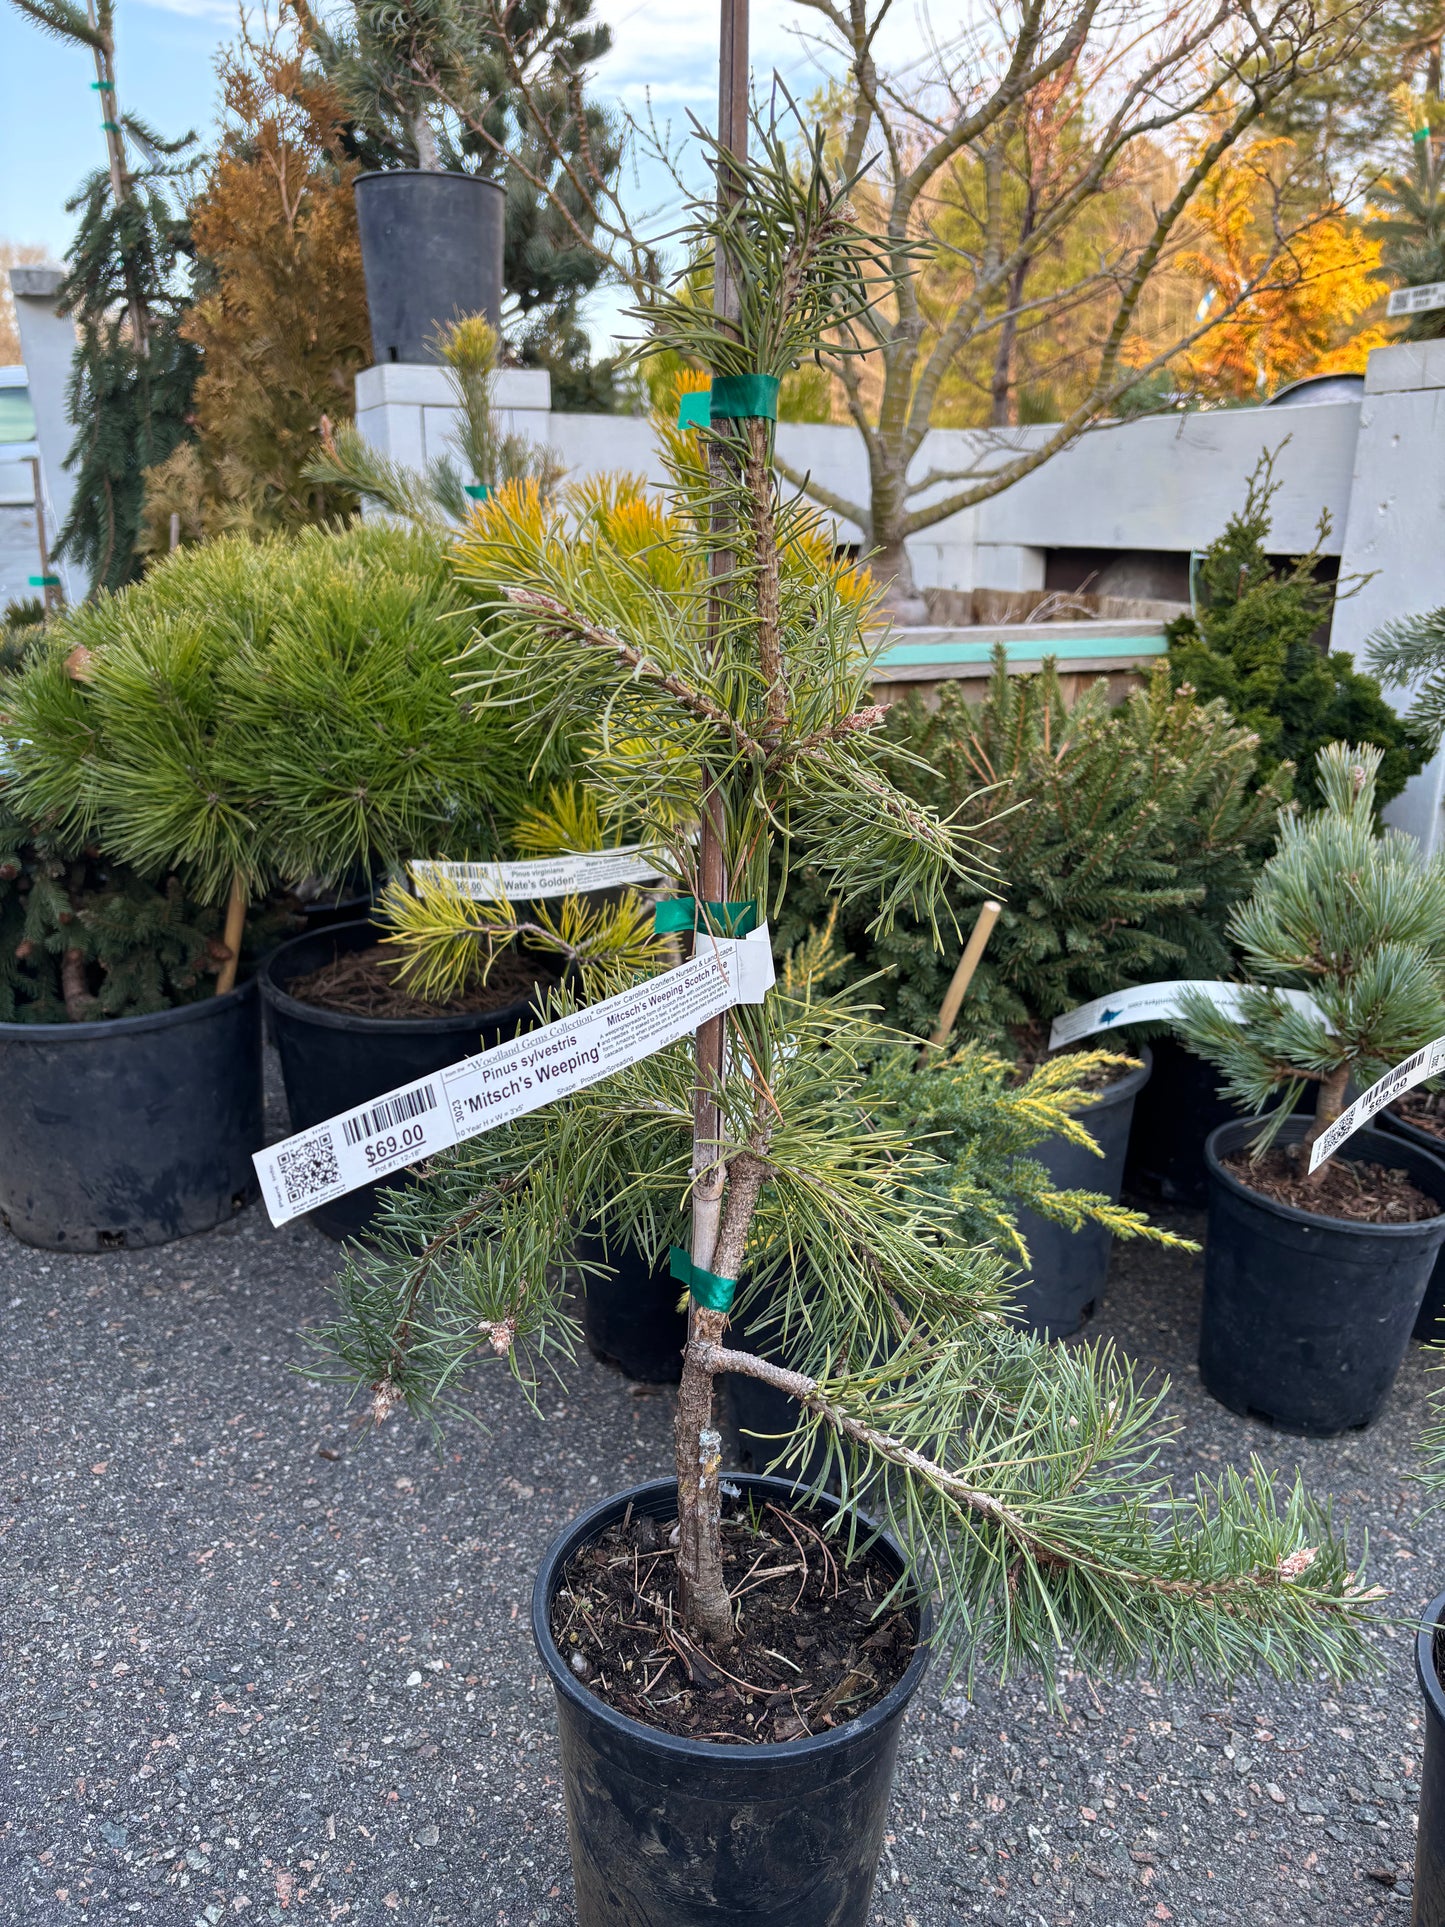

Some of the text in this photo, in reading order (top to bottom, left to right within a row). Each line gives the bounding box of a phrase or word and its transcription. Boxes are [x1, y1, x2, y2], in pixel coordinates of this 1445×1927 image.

[512, 870, 531, 878] Pinus
[521, 1033, 547, 1048] Gems
[595, 1003, 613, 1014] Grown
[622, 987, 649, 1003] Carolina
[649, 975, 675, 990] Conifers
[675, 963, 697, 978] Nursery
[703, 946, 732, 964] Landcape
[606, 1001, 647, 1026] Mitcsch's
[647, 984, 683, 1006] Weeping
[684, 968, 710, 988] Scotch
[699, 1010, 715, 1022] USDA
[601, 1037, 610, 1045] and
[659, 1031, 679, 1045] Full Sun
[482, 1035, 576, 1083] Pinus sylvestris
[579, 1055, 633, 1084] Prostrate/Spreading
[463, 1041, 606, 1112] 'Mitsch's Weeping'
[1368, 1077, 1408, 1113] $69.00
[452, 1099, 466, 1124] 3023
[466, 1122, 482, 1134] Year
[494, 1112, 502, 1120] W
[364, 1124, 423, 1164] $69.00
[374, 1164, 387, 1174] Pot
